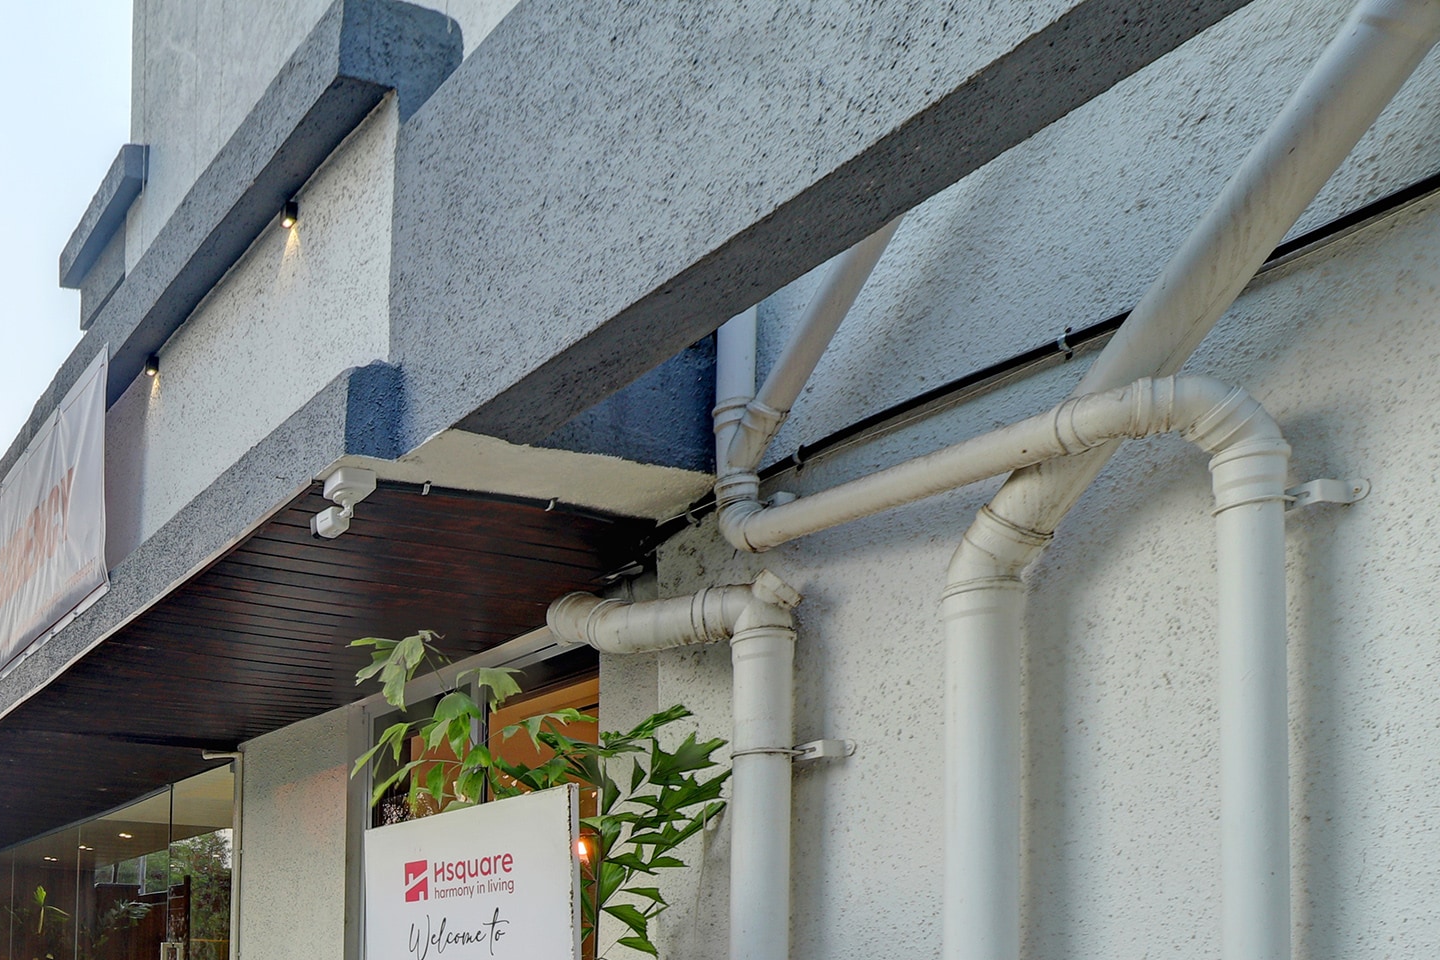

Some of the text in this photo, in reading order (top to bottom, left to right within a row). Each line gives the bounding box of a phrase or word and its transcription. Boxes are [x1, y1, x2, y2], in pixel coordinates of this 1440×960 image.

[434, 853, 514, 883] Hsquare
[434, 878, 514, 900] harmony in living
[482, 907, 510, 956] to
